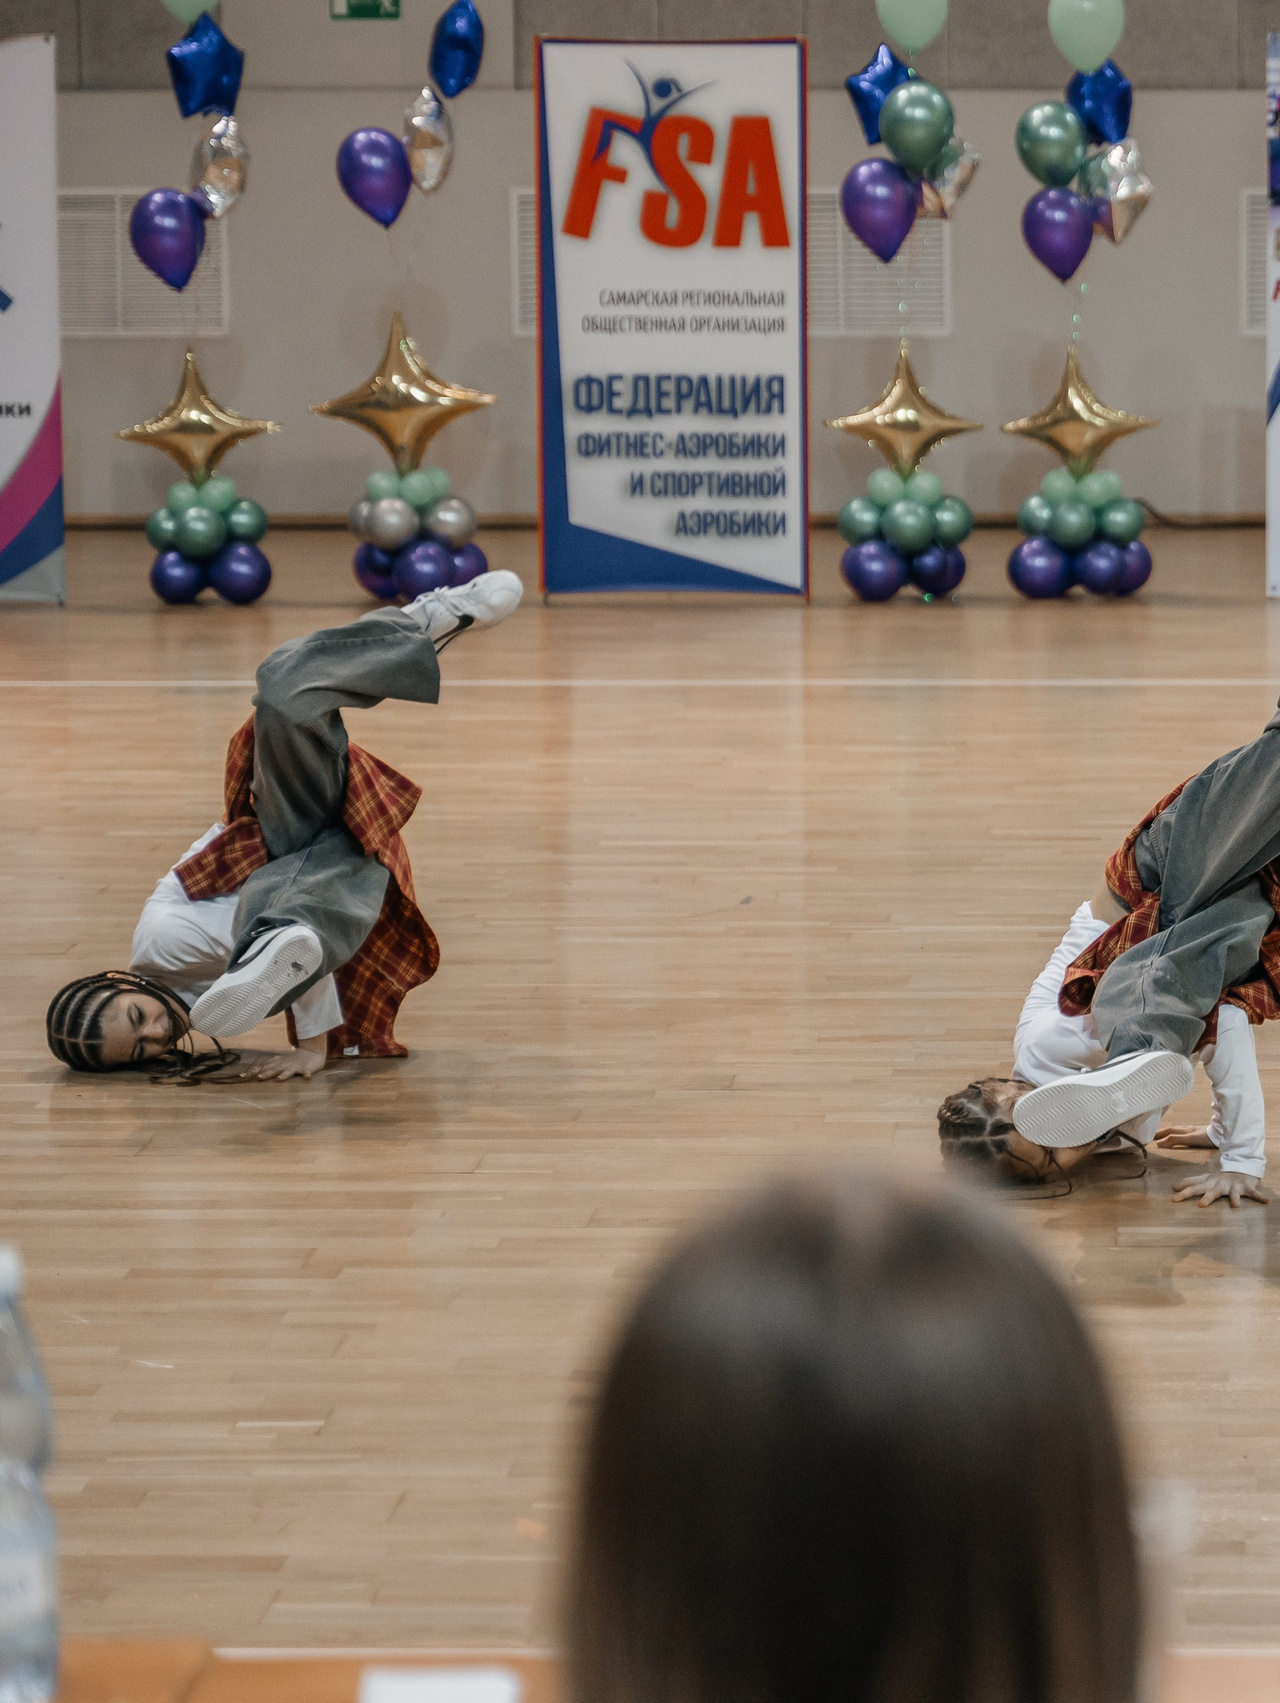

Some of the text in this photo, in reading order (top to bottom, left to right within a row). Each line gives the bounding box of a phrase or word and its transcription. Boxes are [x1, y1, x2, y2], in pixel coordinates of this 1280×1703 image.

[562, 106, 790, 247] FSA
[599, 289, 785, 307] САМАРСКАЯ РЕГИОНАЛЬНАЯ
[581, 314, 785, 335] ОБЩЕСТВЕННАЯ ОРГАНИЗАЦИЯ
[573, 374, 785, 419] ФЕДЕРАЦИЯ
[577, 432, 785, 458] ФИТНЕС-АЭРОБИКИ
[630, 467, 785, 497] И СПОРТИВНОЙ
[675, 511, 785, 536] АЭРОБИКИ
